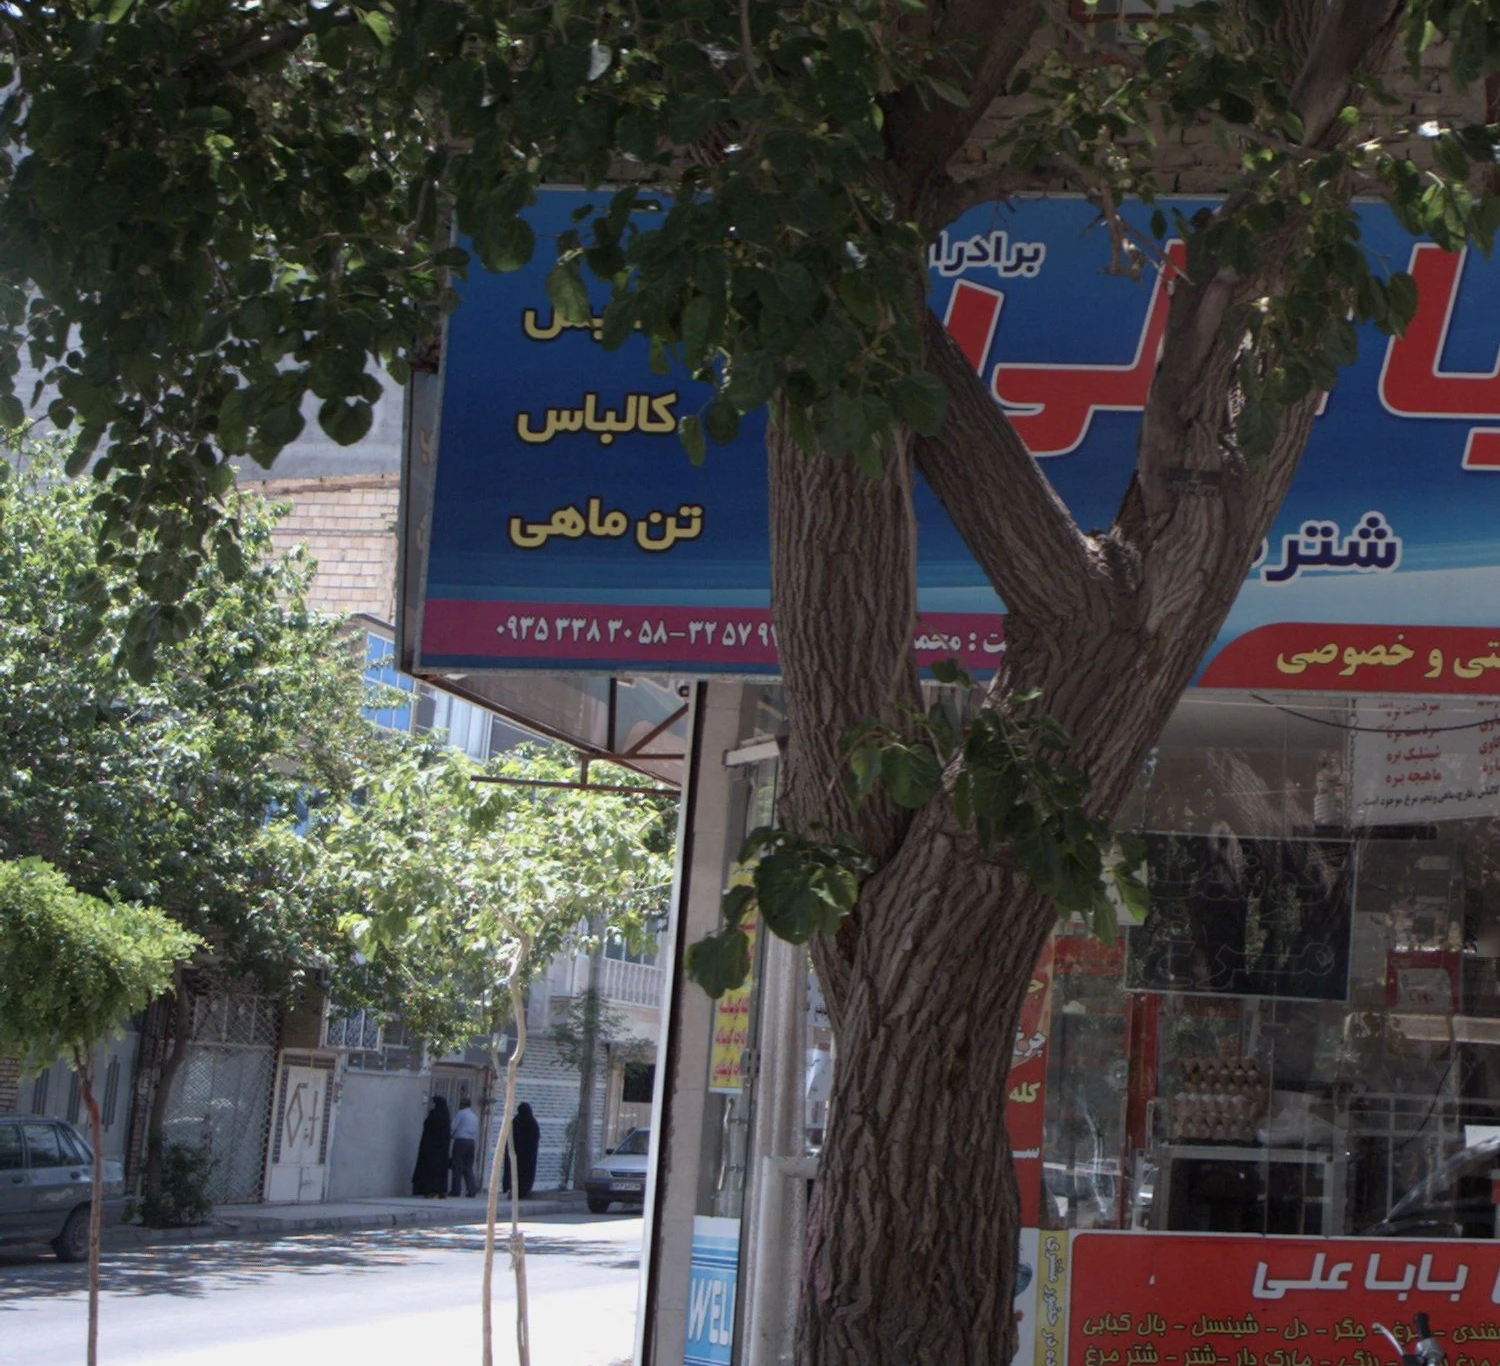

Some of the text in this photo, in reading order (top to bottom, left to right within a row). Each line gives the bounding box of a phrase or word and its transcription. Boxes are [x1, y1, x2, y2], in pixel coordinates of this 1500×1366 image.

[929, 230, 1046, 277] برادرا
[517, 392, 678, 445] کالباس
[510, 498, 705, 551] تن ماهی
[1266, 512, 1401, 583] شتر
[913, 634, 961, 651] محم
[1276, 635, 1415, 675] خصوصی
[1424, 648, 1443, 678] و
[1252, 1251, 1353, 1299] علی
[1364, 1251, 1469, 1302] بابا
[687, 1275, 738, 1348] WEL
[1082, 1311, 1133, 1341] کبابی
[1136, 1313, 1167, 1338] بال
[1283, 1317, 1309, 1340] دل
[1393, 1319, 1419, 1347] رغ
